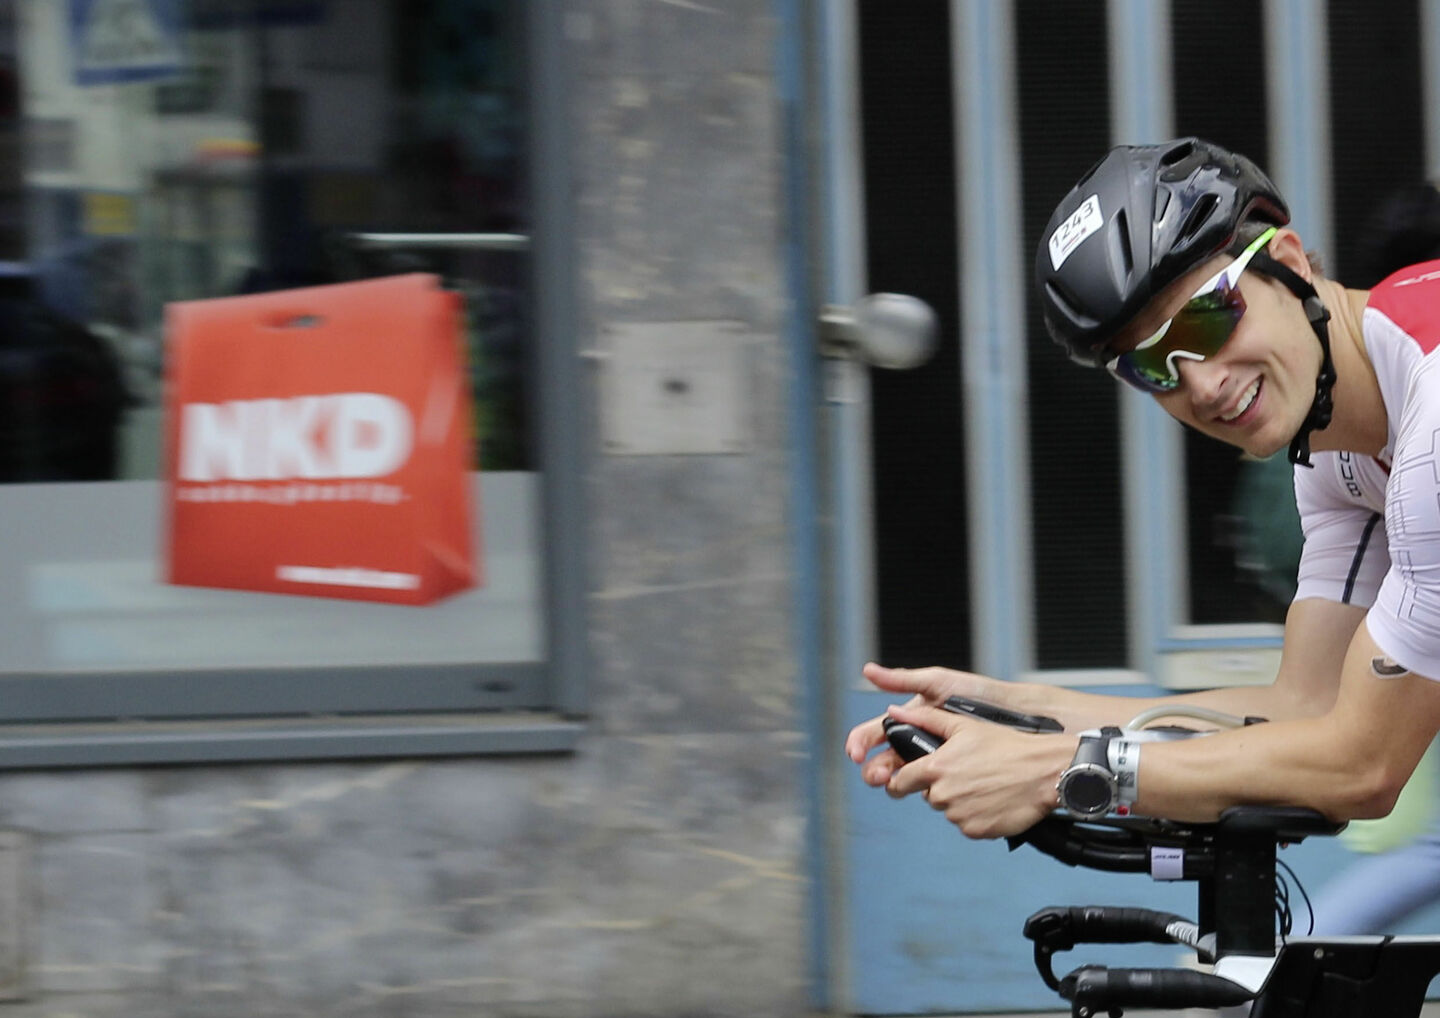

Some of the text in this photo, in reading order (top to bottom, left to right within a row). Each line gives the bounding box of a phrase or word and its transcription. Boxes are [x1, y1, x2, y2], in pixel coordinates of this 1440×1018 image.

[1052, 202, 1094, 248] 1243
[179, 391, 416, 482] NKD
[1339, 450, 1362, 497] UUB
